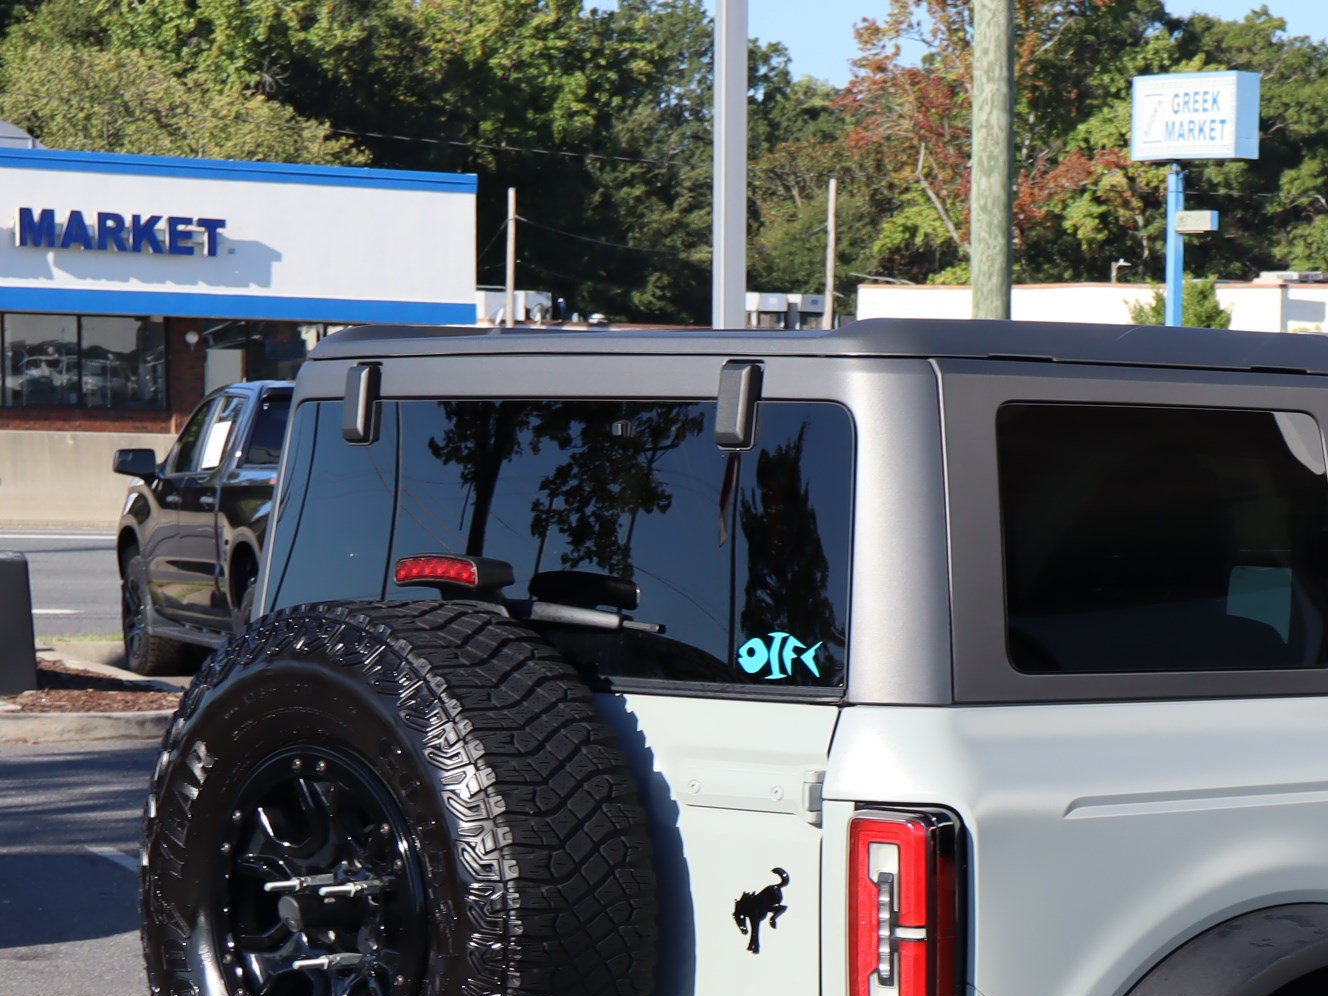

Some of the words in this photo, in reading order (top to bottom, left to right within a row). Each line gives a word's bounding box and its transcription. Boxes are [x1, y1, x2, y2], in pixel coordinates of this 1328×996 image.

[1172, 91, 1220, 114] GREEK
[1165, 119, 1227, 141] MARKET
[17, 207, 226, 257] MARKET
